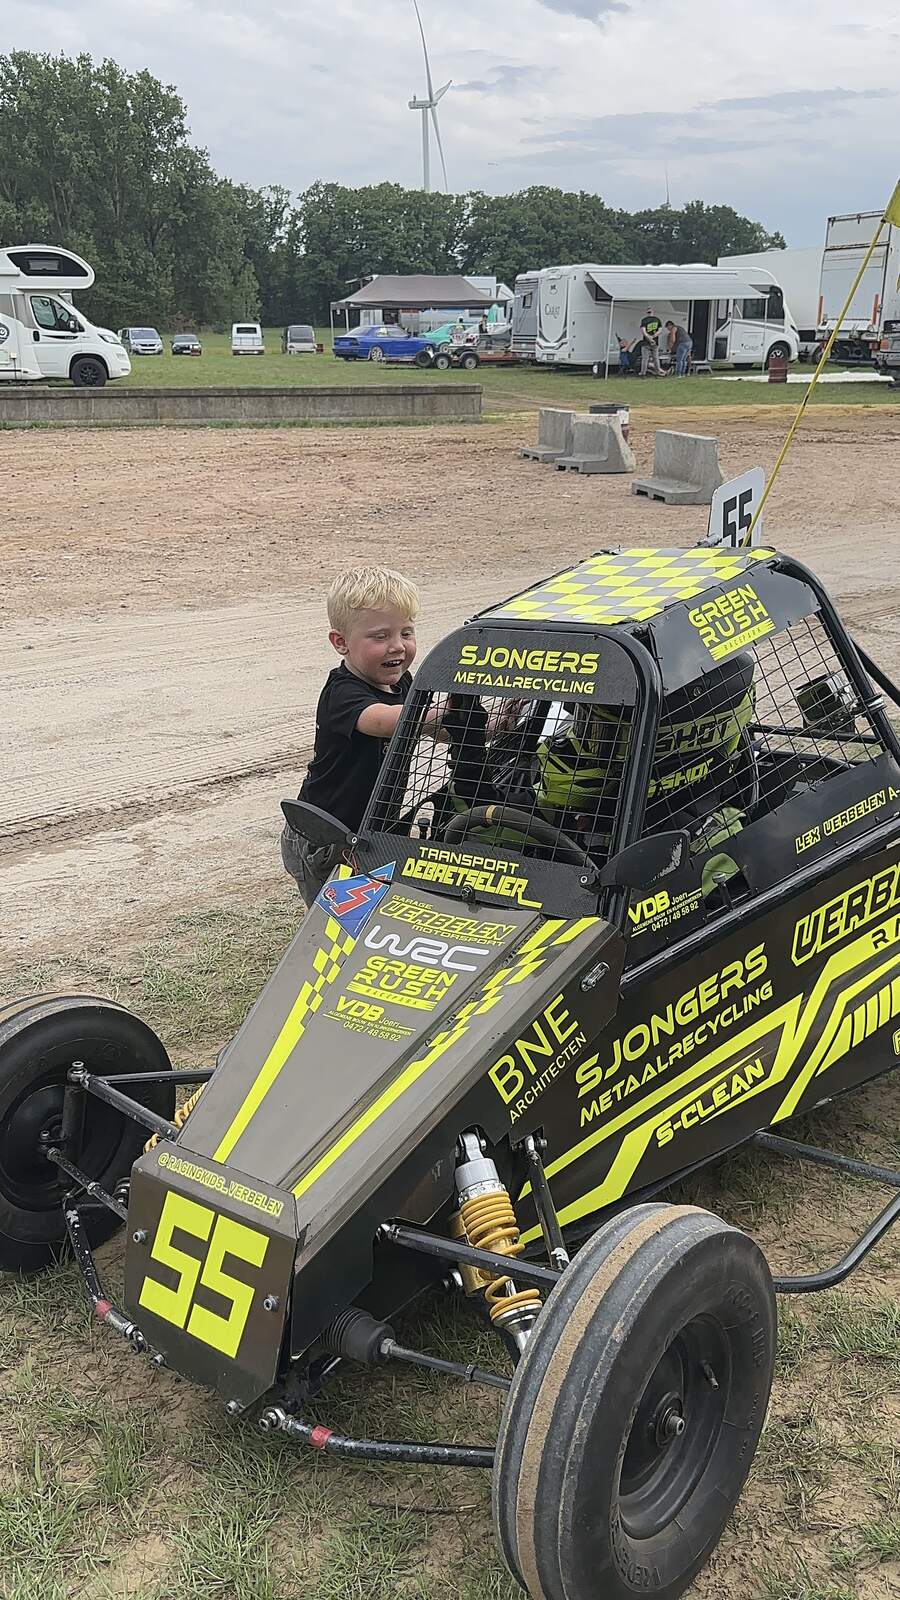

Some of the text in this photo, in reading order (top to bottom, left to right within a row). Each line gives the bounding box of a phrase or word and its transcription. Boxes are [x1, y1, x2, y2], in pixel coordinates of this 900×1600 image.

[723, 488, 752, 547] 55
[688, 583, 758, 627] GREEN
[699, 600, 769, 648] RUSH
[458, 645, 600, 674] SJONGERS
[453, 671, 595, 695] METAALRECYCLING
[795, 826, 821, 854] LEX
[419, 846, 520, 874] TRANSPORT
[391, 894, 434, 910] GARAGE
[628, 890, 670, 925] VDB
[651, 917, 669, 932] 0472
[672, 911, 681, 920] 48
[681, 905, 690, 916] 58
[689, 900, 699, 911] 92
[364, 925, 490, 972] WRC
[411, 925, 506, 947] MOTORSPORT
[353, 967, 449, 1001] RUSH
[366, 955, 459, 987] GREEN
[336, 995, 385, 1022] VDB
[575, 942, 769, 1098] SJONGERS
[343, 1021, 364, 1033] 0472
[367, 1028, 379, 1037] 48
[487, 993, 580, 1105] BNE
[579, 979, 773, 1128] METAALRECYCLING
[509, 1031, 588, 1125] ARCHITECTEN
[656, 1058, 765, 1148] S-CLEAN
[158, 1152, 284, 1217] @RACINGKIDS_VERBELEN
[138, 1190, 270, 1359] 55
